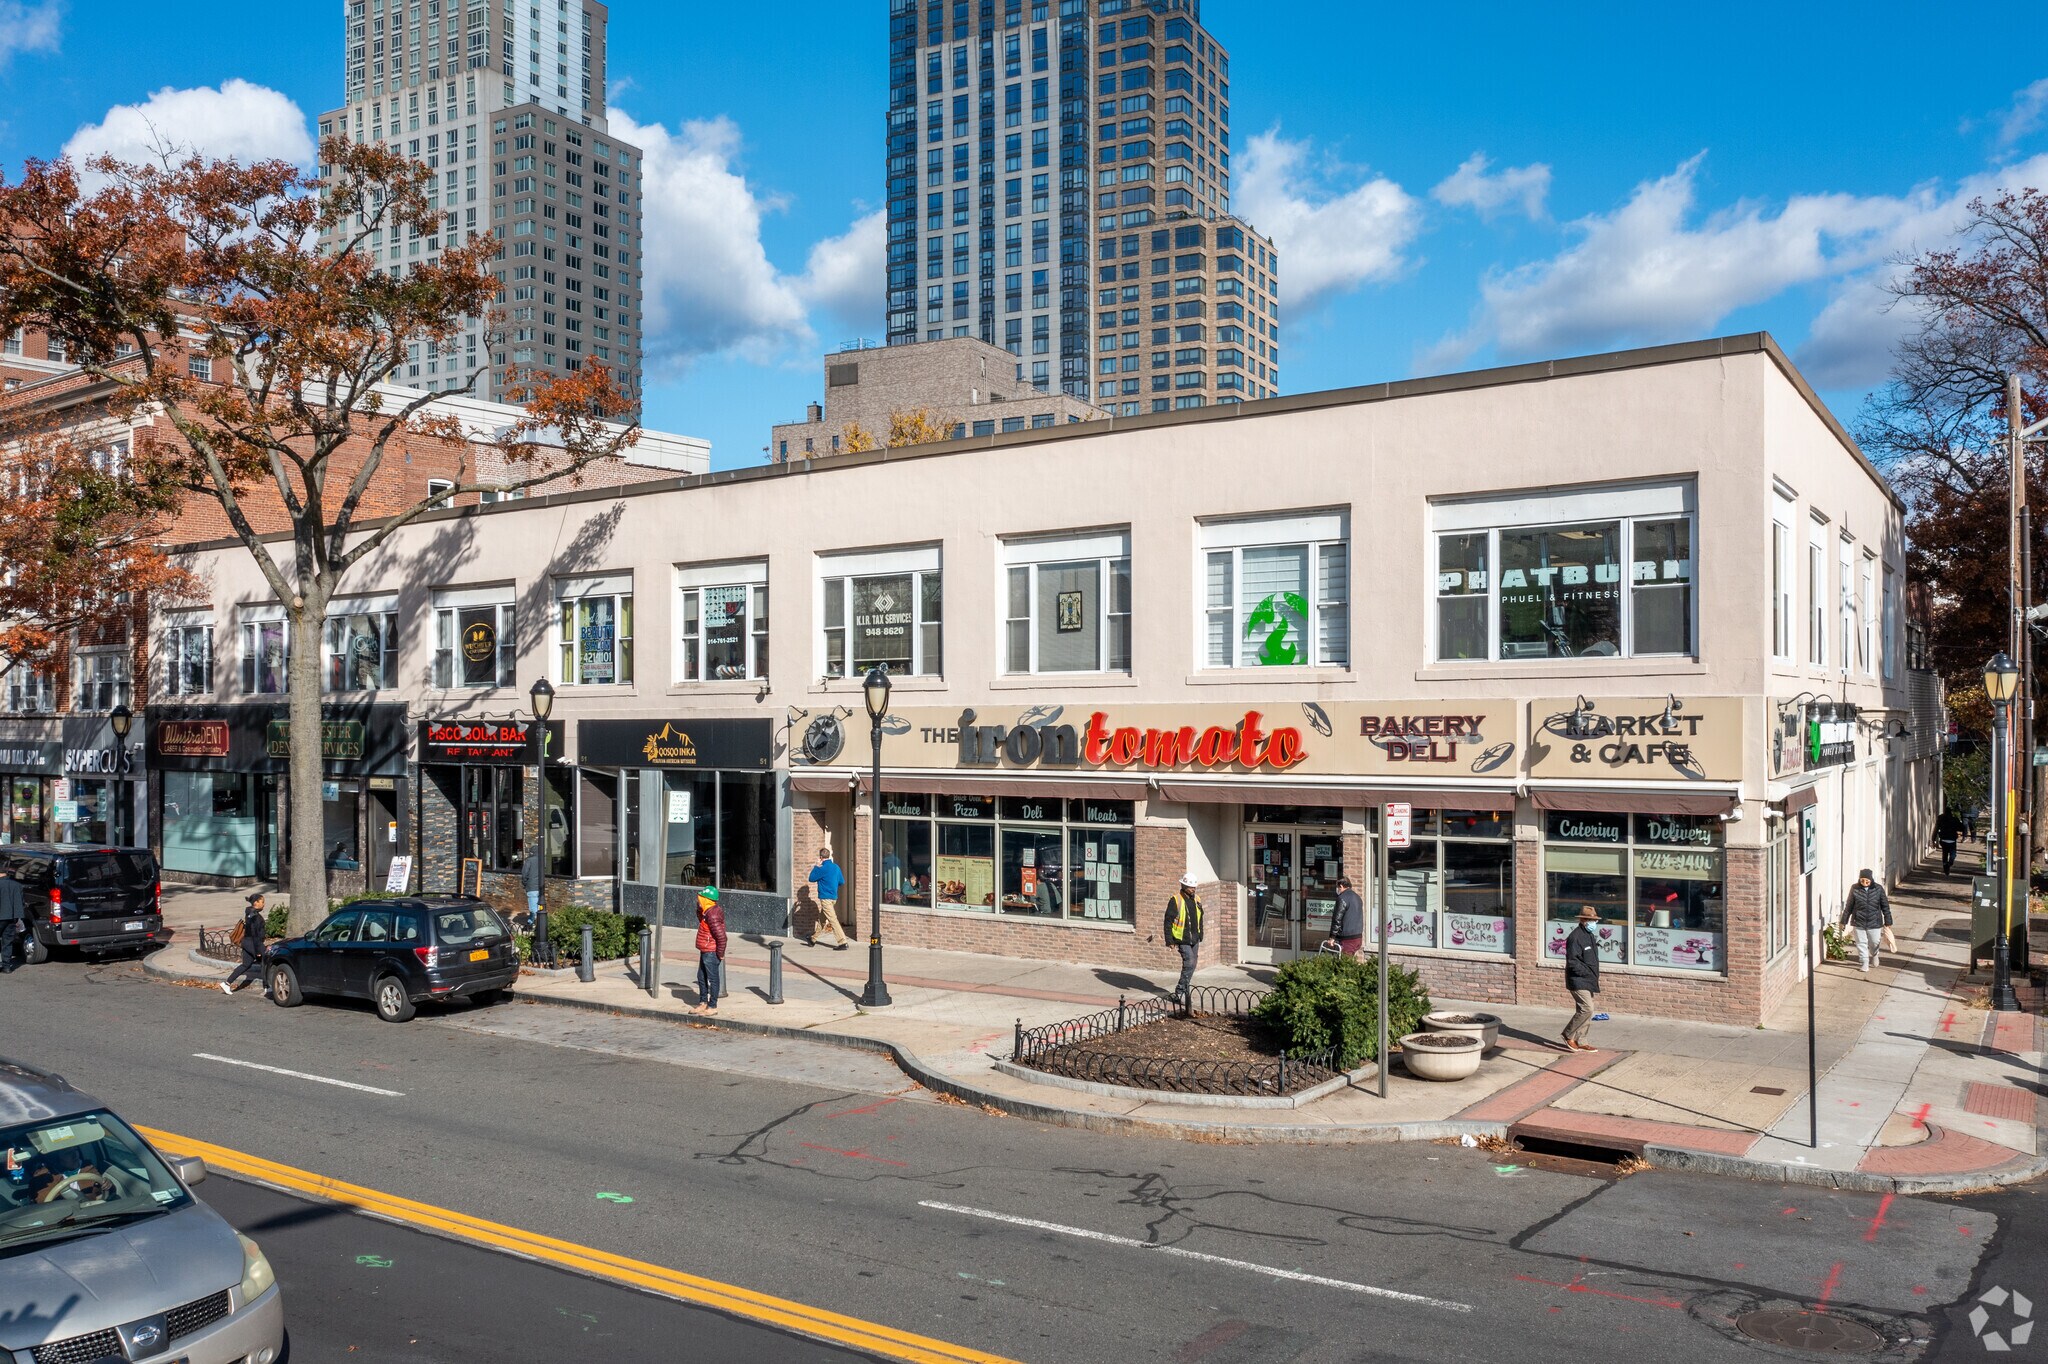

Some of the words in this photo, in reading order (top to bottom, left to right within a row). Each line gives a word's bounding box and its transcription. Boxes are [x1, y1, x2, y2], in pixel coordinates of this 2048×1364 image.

[1439, 558, 1690, 591] PHATBURN
[1501, 595, 1542, 604] PHUEL
[1563, 590, 1620, 601] FITNESS
[872, 613, 884, 625] TAX
[885, 612, 912, 625] SERVICES
[581, 625, 614, 639] BEAUTY
[865, 626, 904, 636] 948-8620
[585, 640, 611, 652] SALON
[1360, 715, 1486, 737] BAKERY
[1565, 715, 1704, 737] MARKET
[920, 727, 958, 743] THE
[959, 708, 1079, 766] iron
[1084, 710, 1308, 769] tomato
[1386, 741, 1458, 763] DELI
[1570, 743, 1592, 764] &
[759, 757, 767, 765] 51
[887, 801, 921, 816] Produce
[953, 803, 979, 817] Pizza
[1022, 804, 1043, 819] Deli
[1087, 806, 1118, 822] Meats
[1559, 819, 1619, 842] Catering
[1647, 819, 1711, 846] Delivery
[1393, 917, 1434, 941] Bakery
[1450, 918, 1492, 931] Custom
[1465, 930, 1497, 943] Cakes
